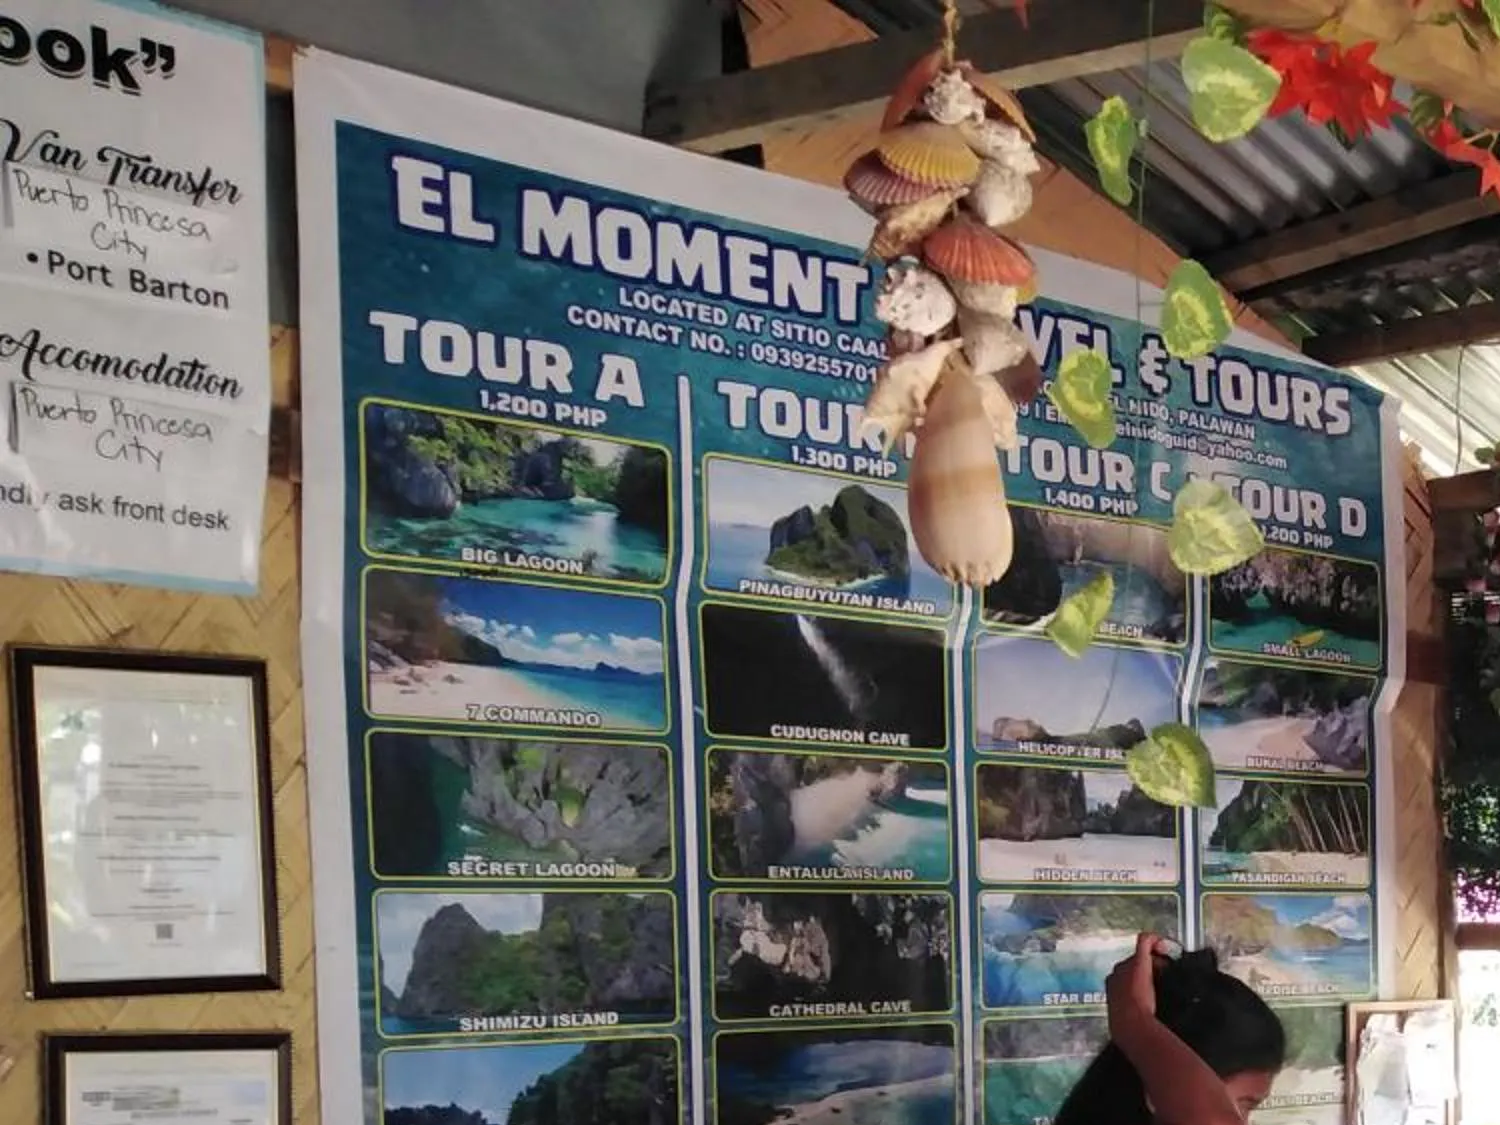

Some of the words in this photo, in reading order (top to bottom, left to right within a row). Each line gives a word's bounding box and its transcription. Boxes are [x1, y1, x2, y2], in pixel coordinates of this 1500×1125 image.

[0, 118, 87, 172] Van
[97, 146, 242, 208] Transfer
[14, 167, 89, 212] Puerto
[103, 188, 212, 242] Princesa
[90, 222, 148, 264] City
[48, 250, 114, 289] Port
[129, 267, 229, 310] Barton
[392, 156, 494, 242] EL
[522, 189, 868, 321] MOMENT
[1138, 338, 1170, 394] &
[1183, 356, 1351, 435] TOURS
[0, 328, 243, 400] Accomodation
[369, 311, 573, 394] TOUR
[595, 354, 645, 408] A
[567, 305, 683, 345] CONTACT
[690, 331, 731, 356] NO.
[751, 342, 878, 383] 0939255701
[618, 286, 728, 327] LOCATED
[735, 314, 764, 334] AT
[771, 318, 831, 348] SITIO
[836, 332, 891, 361] CAAL
[1178, 408, 1255, 440] PALAWAN
[21, 385, 97, 426] Puerto
[110, 397, 214, 442] Princesa
[555, 404, 608, 429] PHP
[718, 381, 887, 452] TOUR
[95, 430, 163, 471] City
[853, 450, 898, 478] PHP
[1004, 434, 1136, 493] TOUR
[1151, 461, 1172, 501] C
[58, 491, 104, 516] ask
[112, 495, 165, 524] front
[172, 505, 230, 531] desk
[1099, 494, 1140, 516] PHP
[1340, 496, 1368, 538] D
[1303, 530, 1334, 550] PHP
[461, 547, 498, 564] BIG
[504, 551, 583, 575] LAGOON
[739, 579, 874, 607] PINAGBUYUTAN
[877, 596, 936, 615] ISLAND
[466, 704, 478, 719] 7
[479, 704, 601, 727] COMMANDO
[770, 724, 864, 744] CUDUGNON
[868, 731, 910, 746] CAVE
[447, 860, 529, 878] SECRET
[535, 861, 616, 878] LAGOON
[769, 1001, 866, 1018] CATHEDRAL
[870, 1000, 912, 1014] CAVE
[1043, 992, 1079, 1006] STAR
[1083, 991, 1107, 1004] BEA
[460, 1015, 546, 1032] SHIMIZU
[552, 1011, 619, 1028] ISLAND
